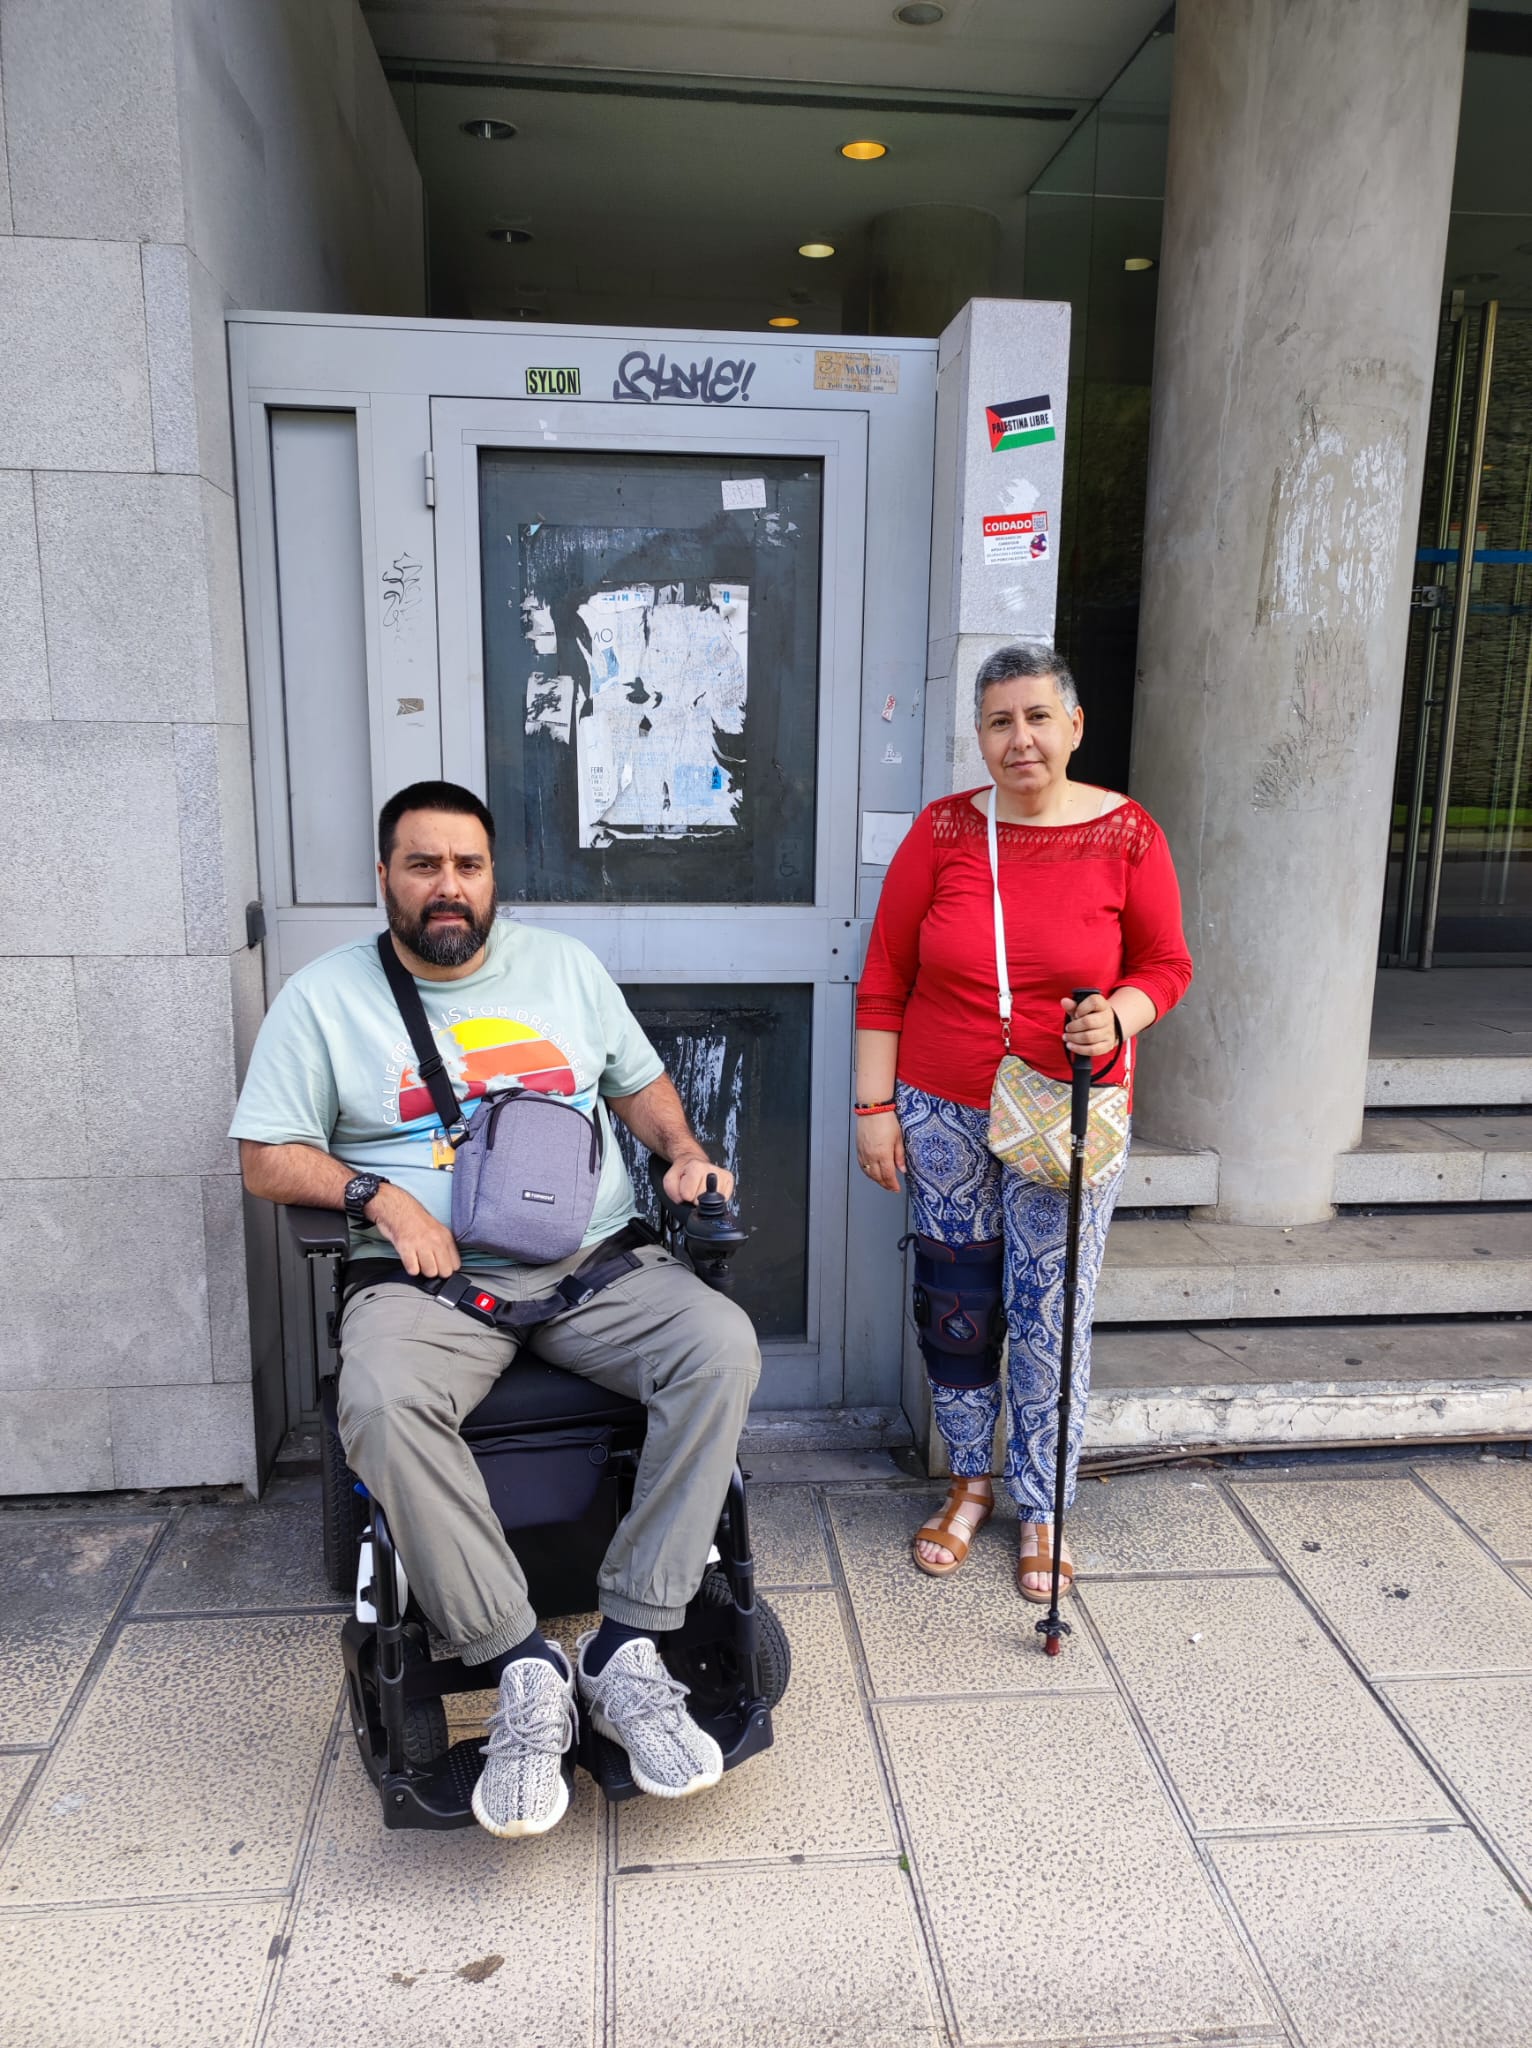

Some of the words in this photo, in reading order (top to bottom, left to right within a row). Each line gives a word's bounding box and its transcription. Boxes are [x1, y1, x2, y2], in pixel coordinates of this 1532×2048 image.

[529, 370, 578, 395] SYLON
[991, 417, 1029, 435] PALESTINA
[1029, 412, 1049, 427] LIBRE
[985, 519, 1032, 532] COIDADO
[383, 1021, 441, 1125] CALIFORA
[441, 1007, 462, 1026] IS
[467, 1005, 509, 1018] FOR
